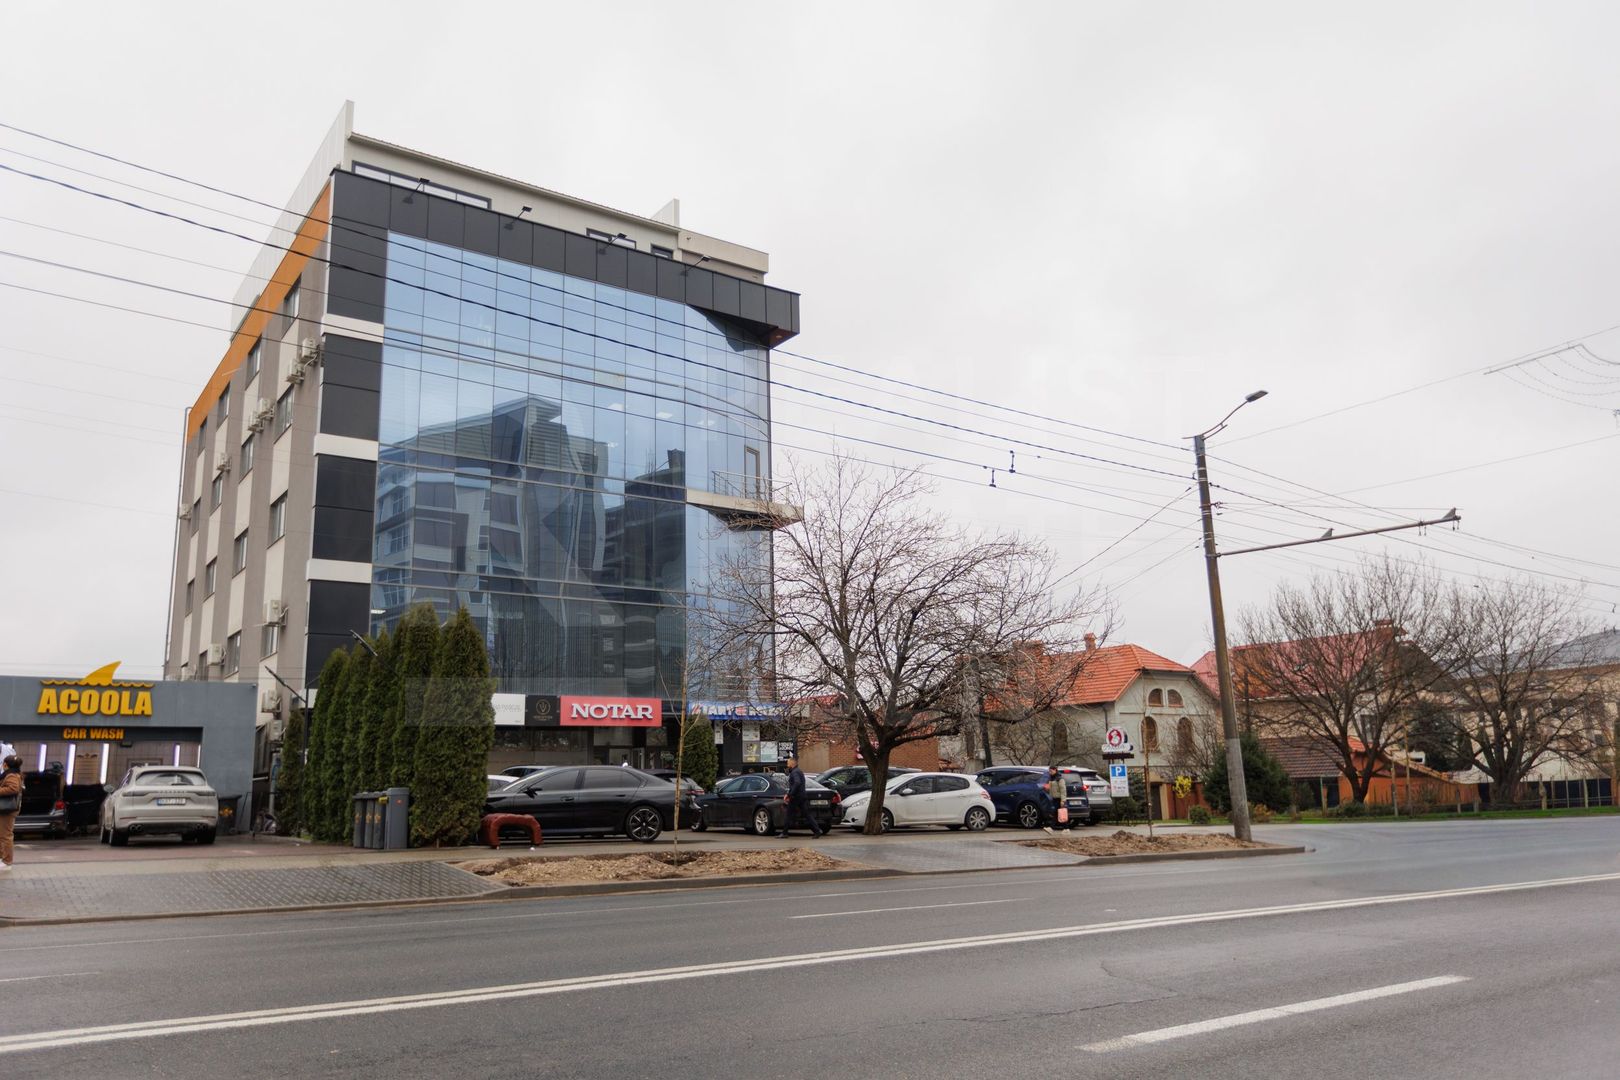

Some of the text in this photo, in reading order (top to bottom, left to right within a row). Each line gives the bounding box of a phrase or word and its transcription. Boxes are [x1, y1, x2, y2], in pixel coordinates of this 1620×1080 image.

[37, 688, 153, 716] ACOOLA
[570, 703, 654, 720] NOTAR
[63, 727, 125, 740] CAR WASH
[1115, 766, 1122, 777] P
